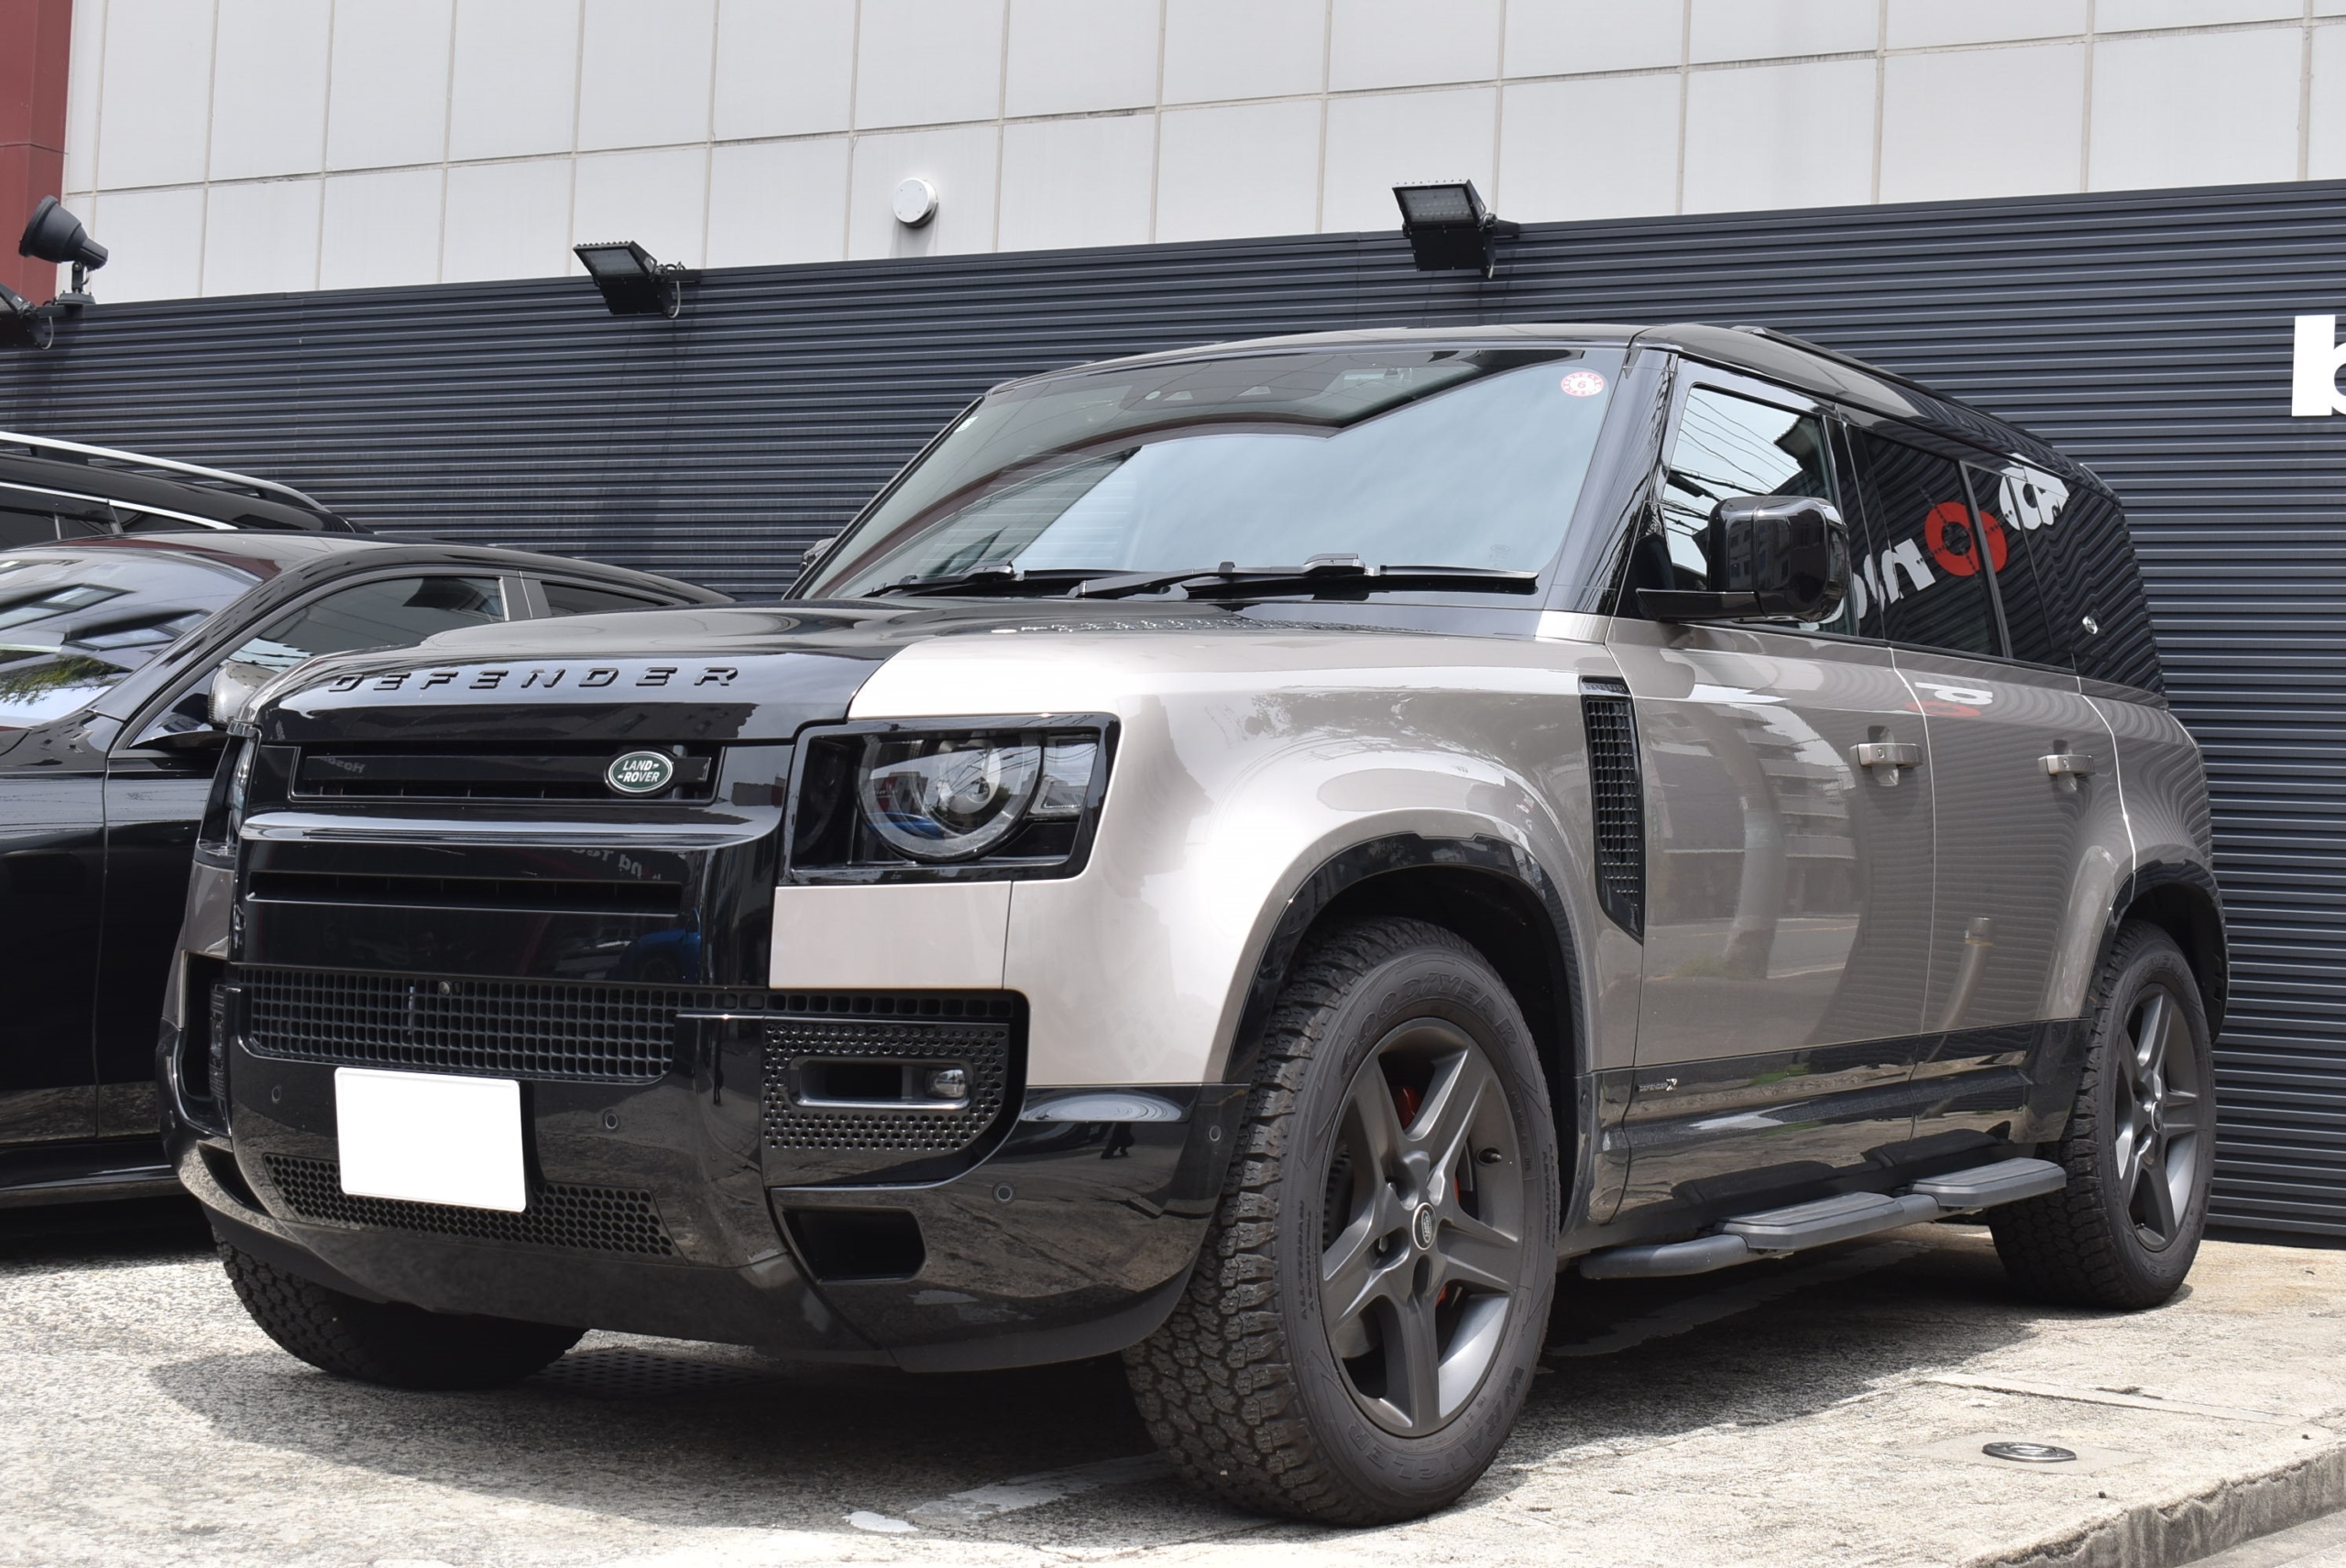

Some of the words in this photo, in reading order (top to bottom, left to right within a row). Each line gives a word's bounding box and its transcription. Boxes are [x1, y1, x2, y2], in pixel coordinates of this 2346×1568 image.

[328, 665, 739, 693] DEFENDER
[1342, 970, 1518, 1077] GOODYEAR
[1348, 1365, 1526, 1480] WRANGLER
